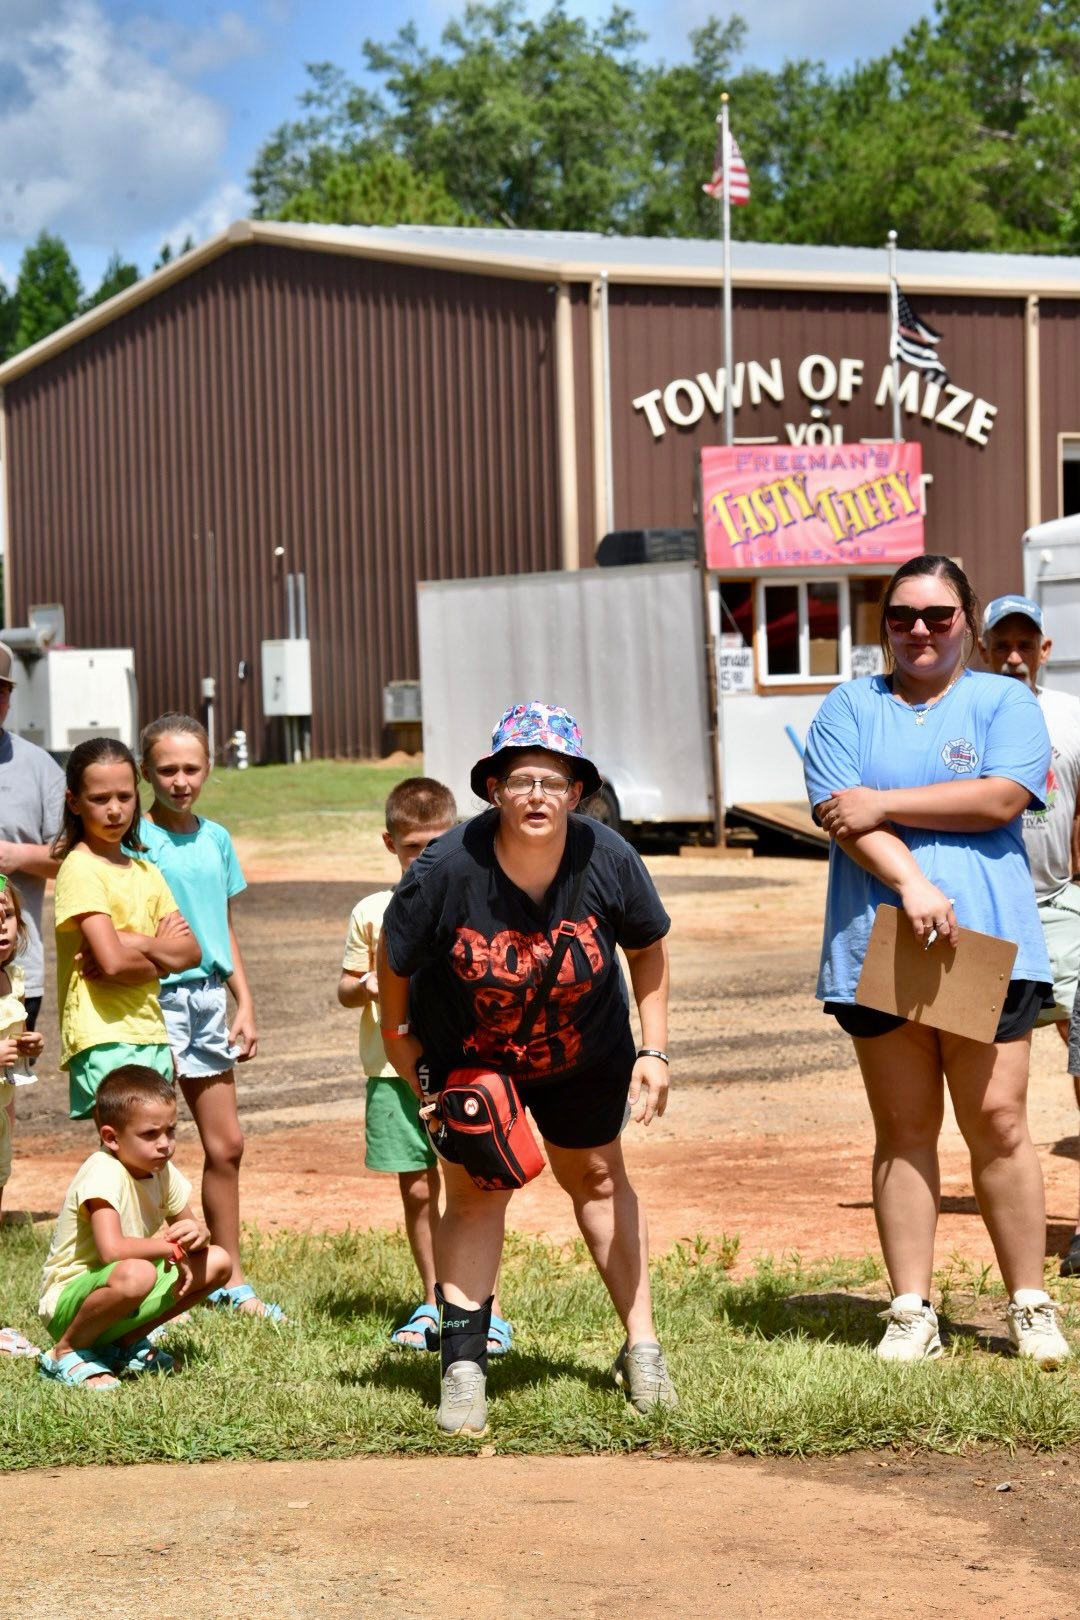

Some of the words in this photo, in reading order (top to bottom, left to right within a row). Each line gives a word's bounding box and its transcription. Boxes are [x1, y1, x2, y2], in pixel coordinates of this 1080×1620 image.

[632, 358, 785, 438] TOWN
[798, 354, 864, 402] OF
[875, 364, 998, 446] MIZE
[736, 447, 890, 473] FREEMAN'S
[709, 470, 817, 549] TASTY
[814, 468, 919, 545] TAFFY
